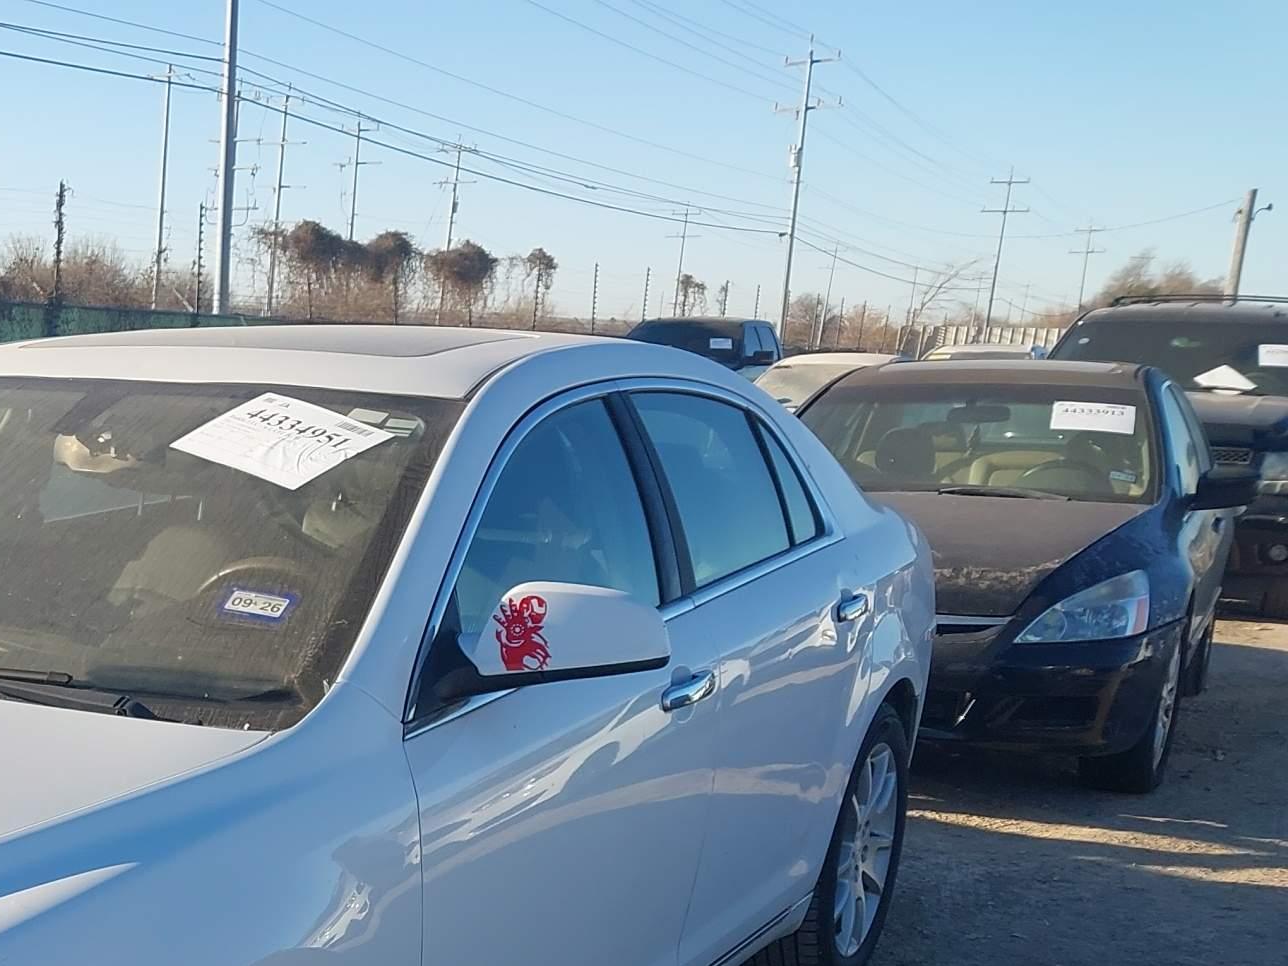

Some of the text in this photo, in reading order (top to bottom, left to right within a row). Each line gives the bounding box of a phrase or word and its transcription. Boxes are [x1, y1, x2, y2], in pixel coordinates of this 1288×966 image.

[247, 409, 352, 448] 44334951
[231, 597, 282, 613] 09 26
